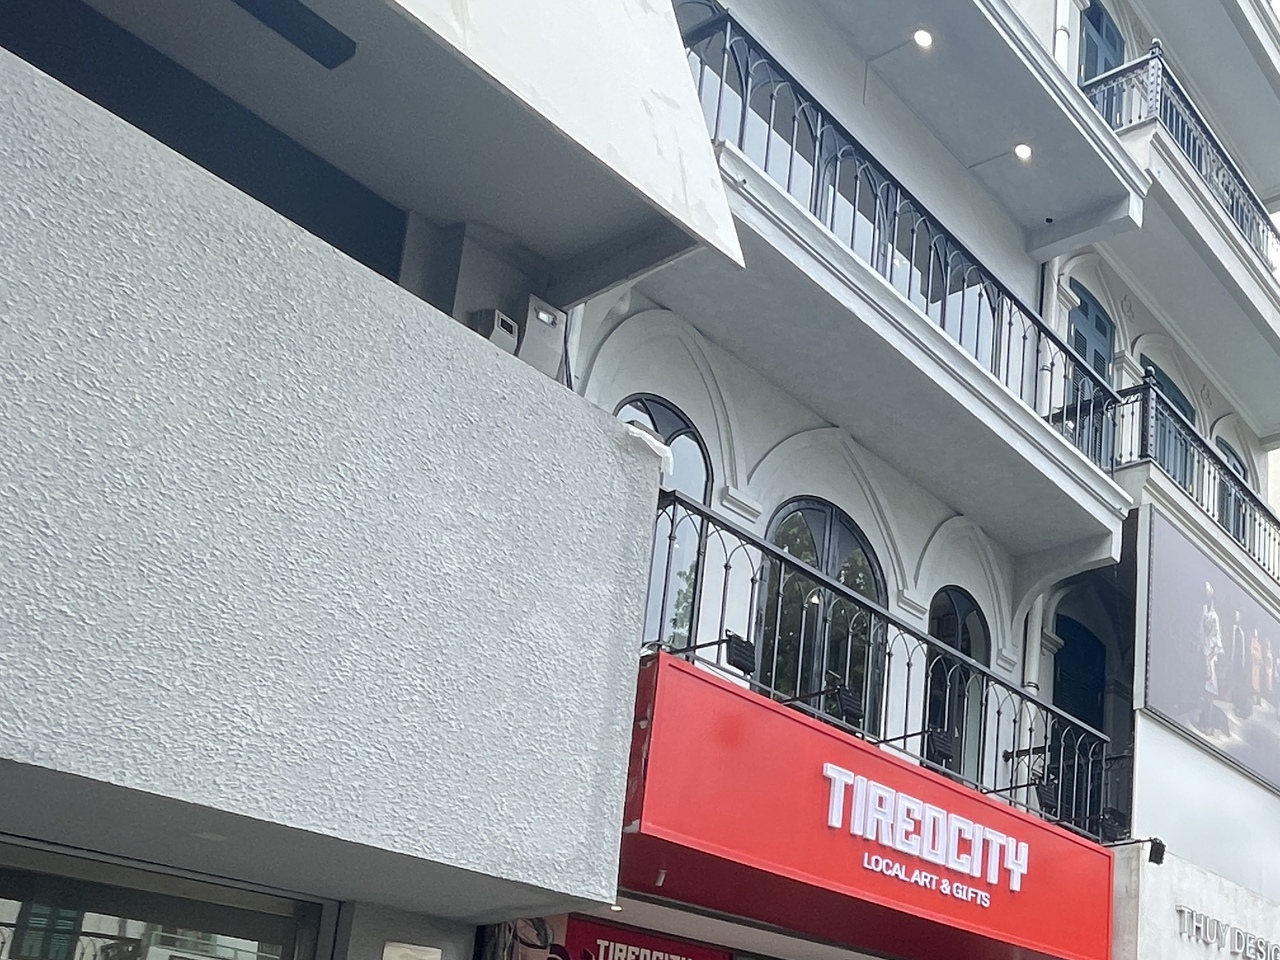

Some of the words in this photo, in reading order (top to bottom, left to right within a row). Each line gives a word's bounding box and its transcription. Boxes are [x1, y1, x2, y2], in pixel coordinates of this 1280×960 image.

[823, 763, 1029, 892] TIREDCITY
[863, 851, 909, 882] LOCAL
[910, 869, 939, 890] ART
[940, 878, 951, 895] &
[952, 882, 990, 907] GIFTS
[1175, 904, 1230, 950] THUY
